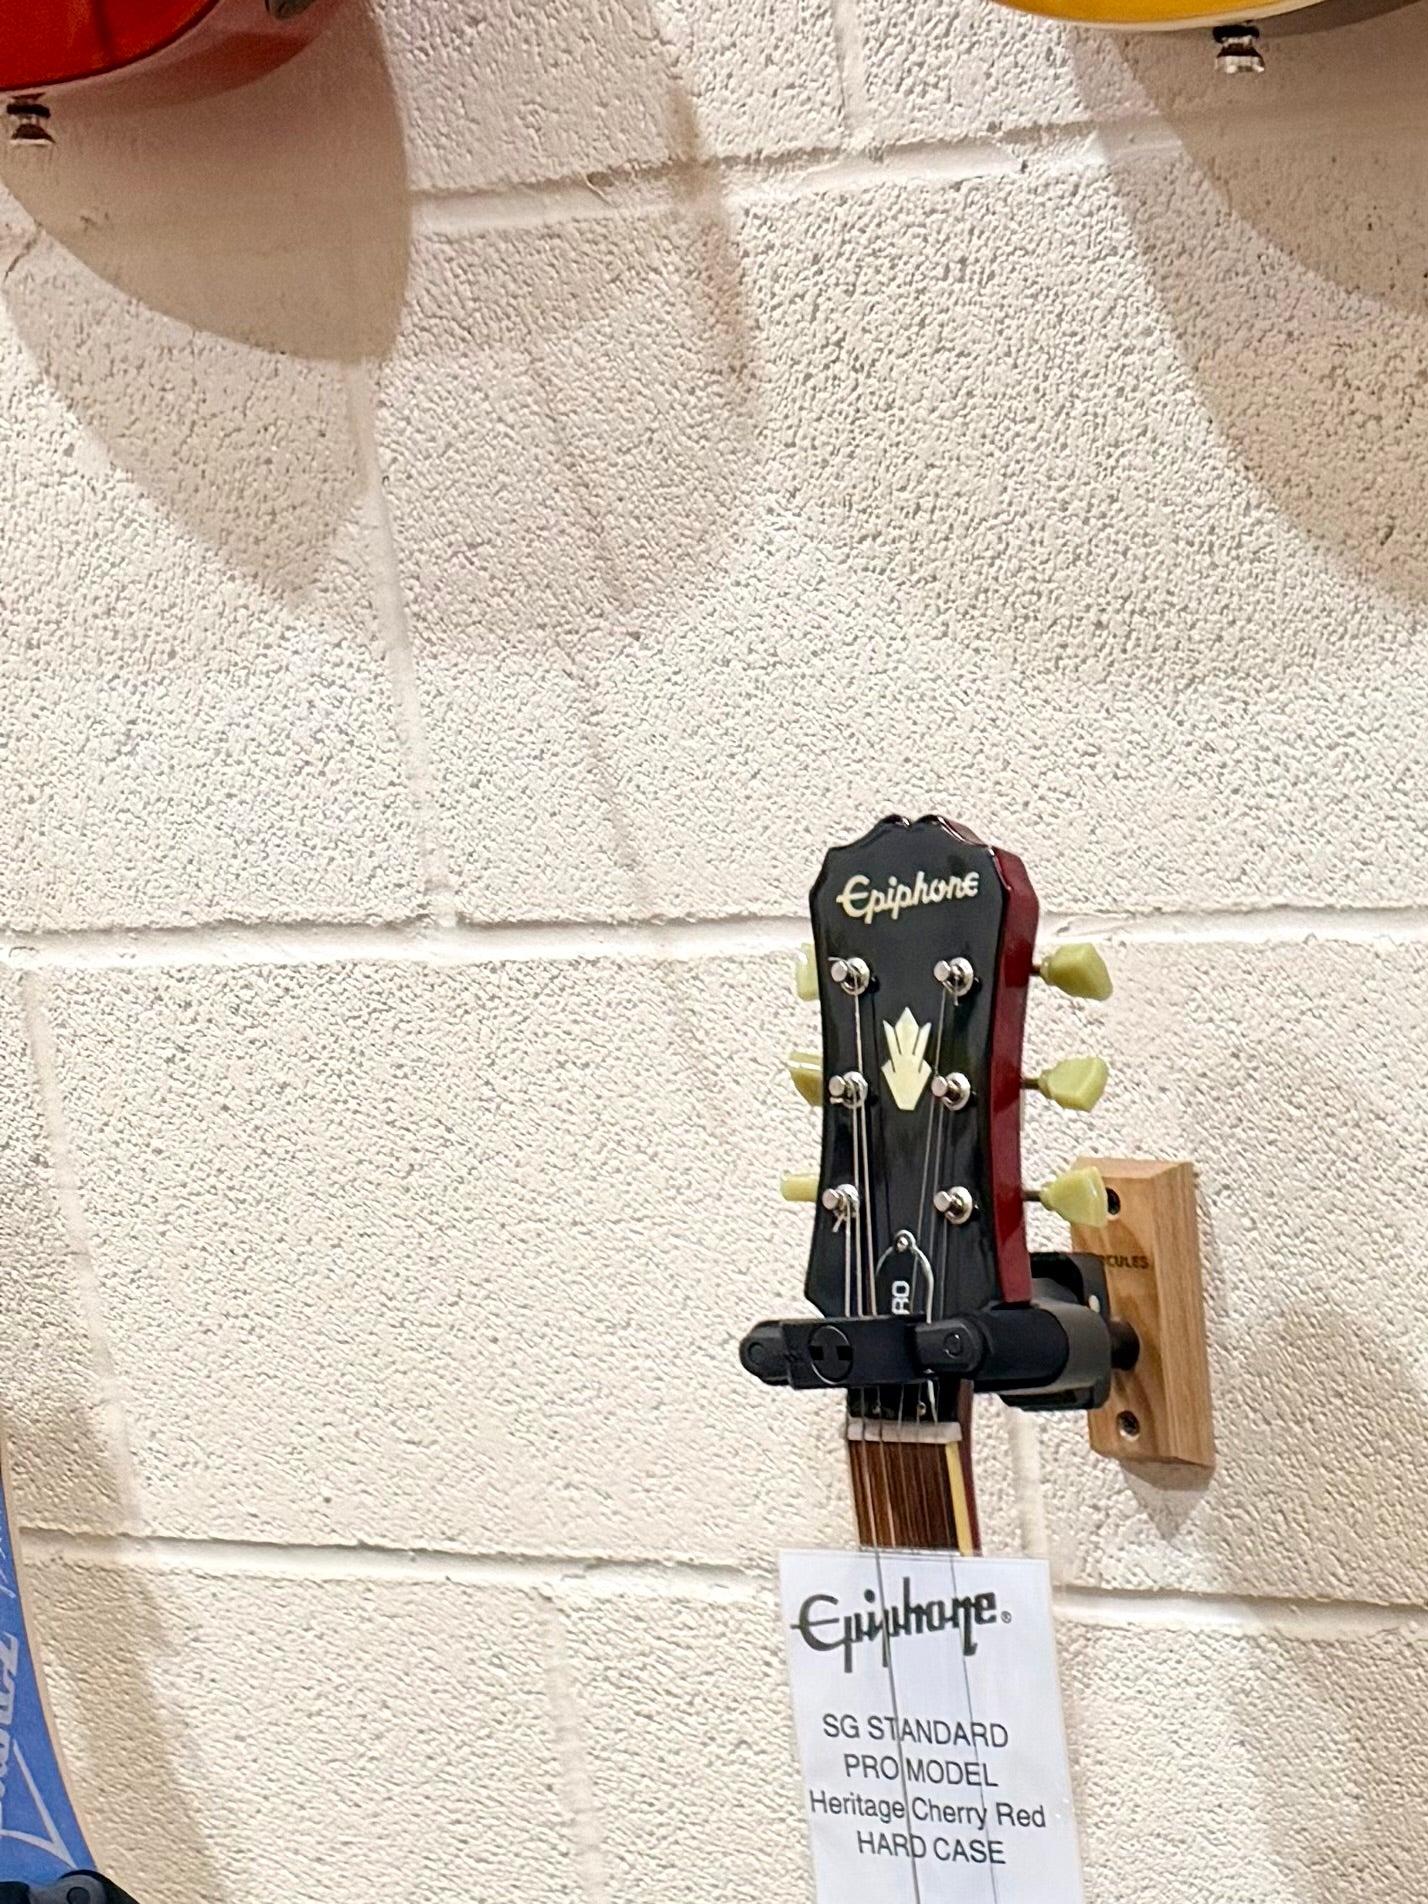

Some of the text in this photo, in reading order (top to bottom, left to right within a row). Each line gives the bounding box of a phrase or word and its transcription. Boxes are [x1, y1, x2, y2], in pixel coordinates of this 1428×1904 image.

[836, 871, 979, 924] Epiphone
[790, 1576, 998, 1674] Epiphone
[823, 1713, 1009, 1748] SG STANDARD
[844, 1754, 998, 1787] PRO MODEL
[809, 1790, 1047, 1830] Heritage Cherry Red
[858, 1831, 1006, 1865] HARD CASE
